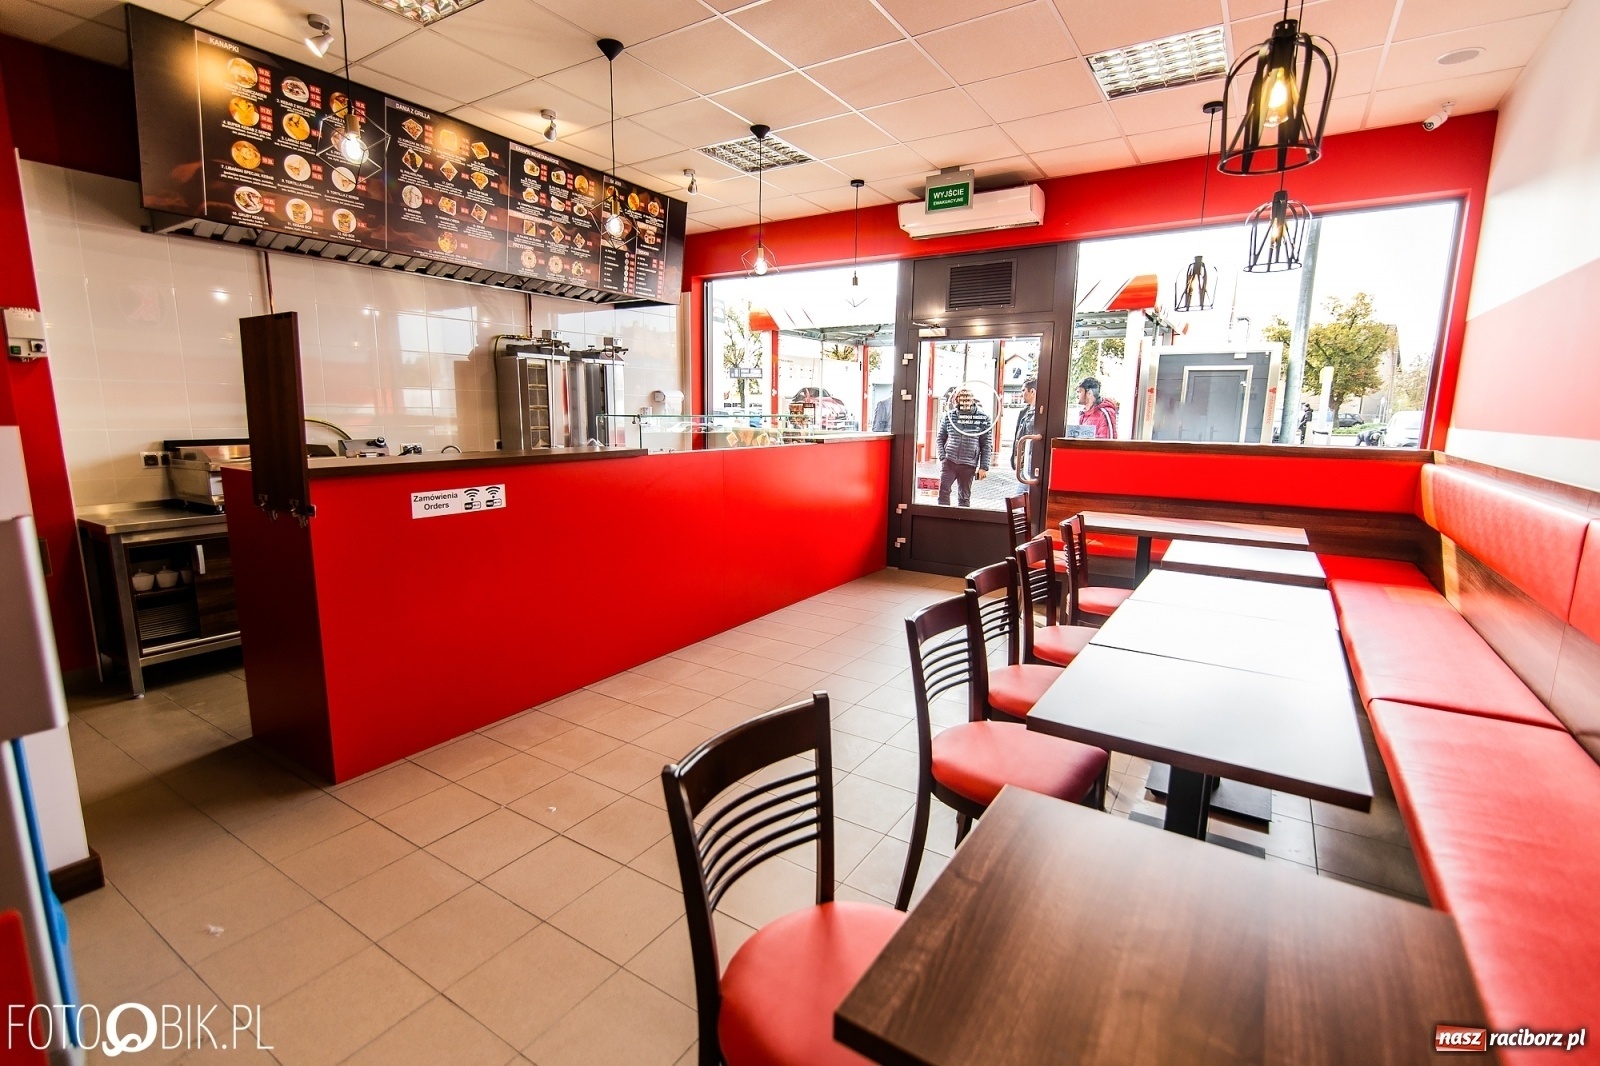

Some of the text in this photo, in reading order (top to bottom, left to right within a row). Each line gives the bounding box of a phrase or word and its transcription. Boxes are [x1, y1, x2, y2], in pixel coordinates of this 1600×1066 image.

[209, 37, 240, 53] KANAPKI
[395, 102, 411, 112] DANIA
[414, 110, 431, 120] GRILLA
[933, 188, 964, 199] WYJŚCIE
[413, 492, 458, 502] Zamówienia
[424, 502, 450, 511] Orders
